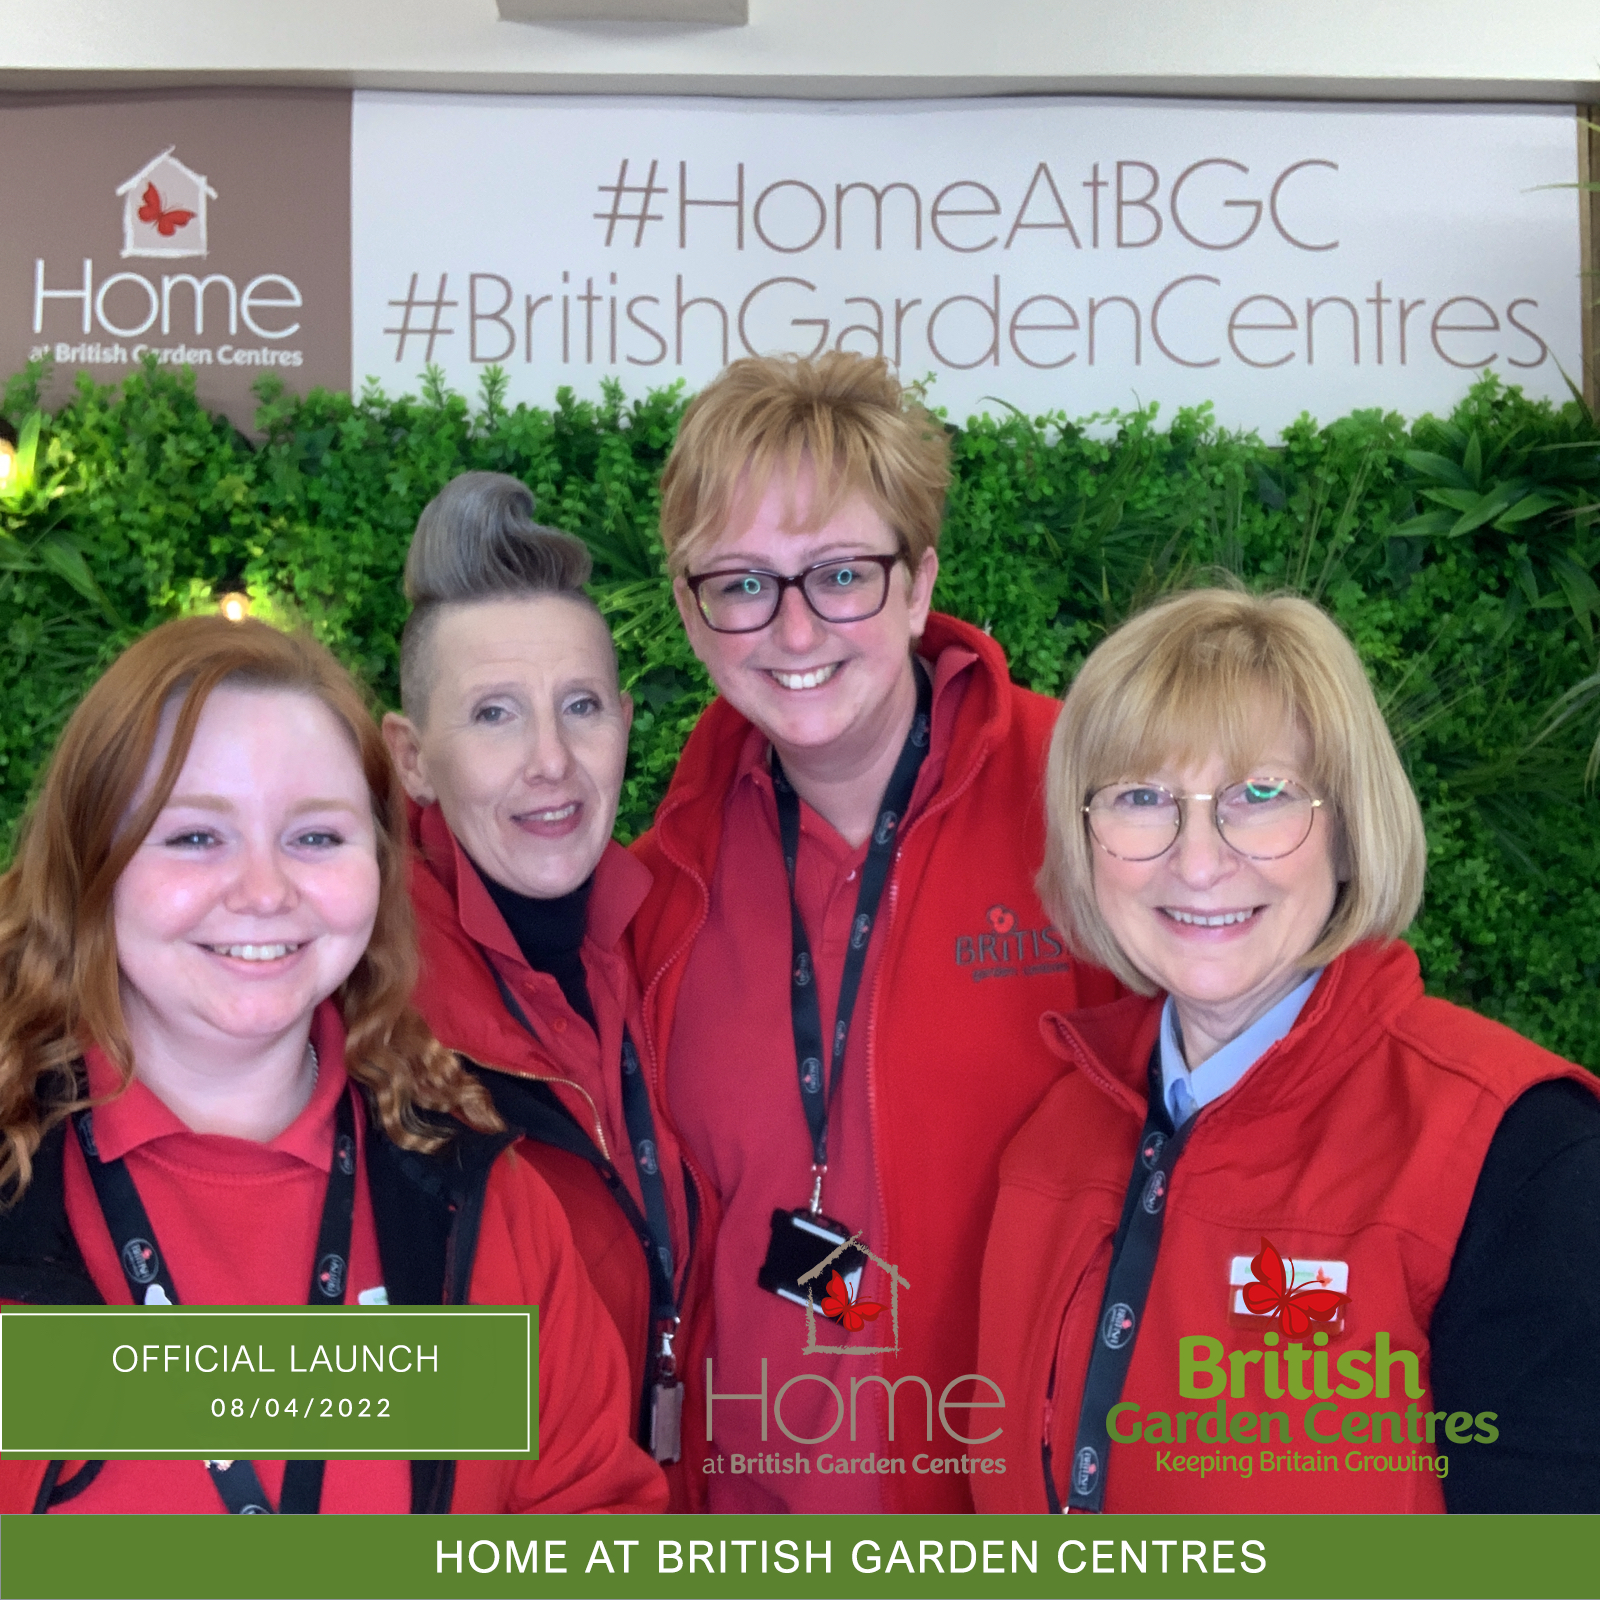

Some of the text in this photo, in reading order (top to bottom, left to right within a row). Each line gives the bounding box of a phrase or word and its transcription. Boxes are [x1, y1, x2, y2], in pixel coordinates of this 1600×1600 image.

[593, 157, 1340, 252] #HomeAtBGC
[33, 258, 304, 338] Home
[383, 270, 1548, 370] #BritishGardenCentres
[54, 343, 128, 364] British
[217, 345, 304, 367] Centres
